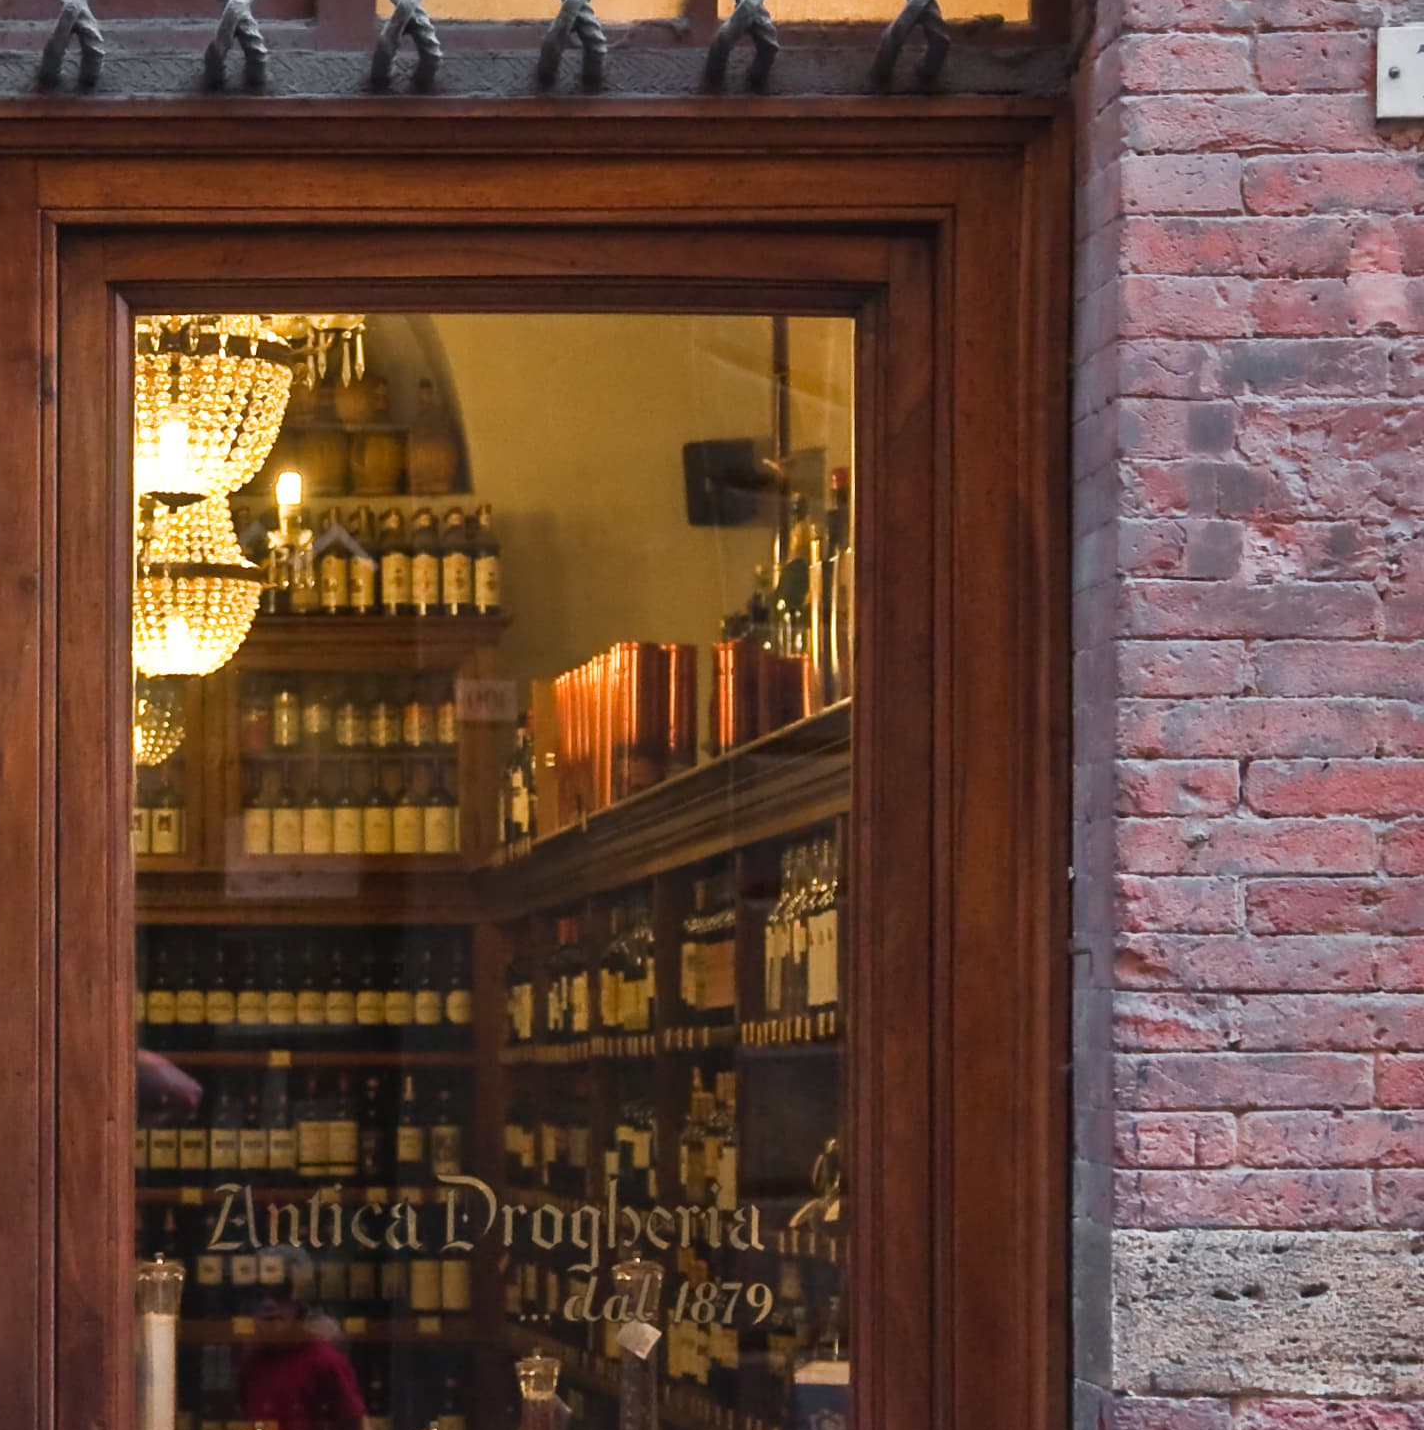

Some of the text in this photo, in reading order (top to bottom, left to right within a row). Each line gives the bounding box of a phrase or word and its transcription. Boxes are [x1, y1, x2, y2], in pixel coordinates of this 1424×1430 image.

[207, 1174, 767, 1275] Antica Drogheria
[676, 1281, 773, 1325] 1879
